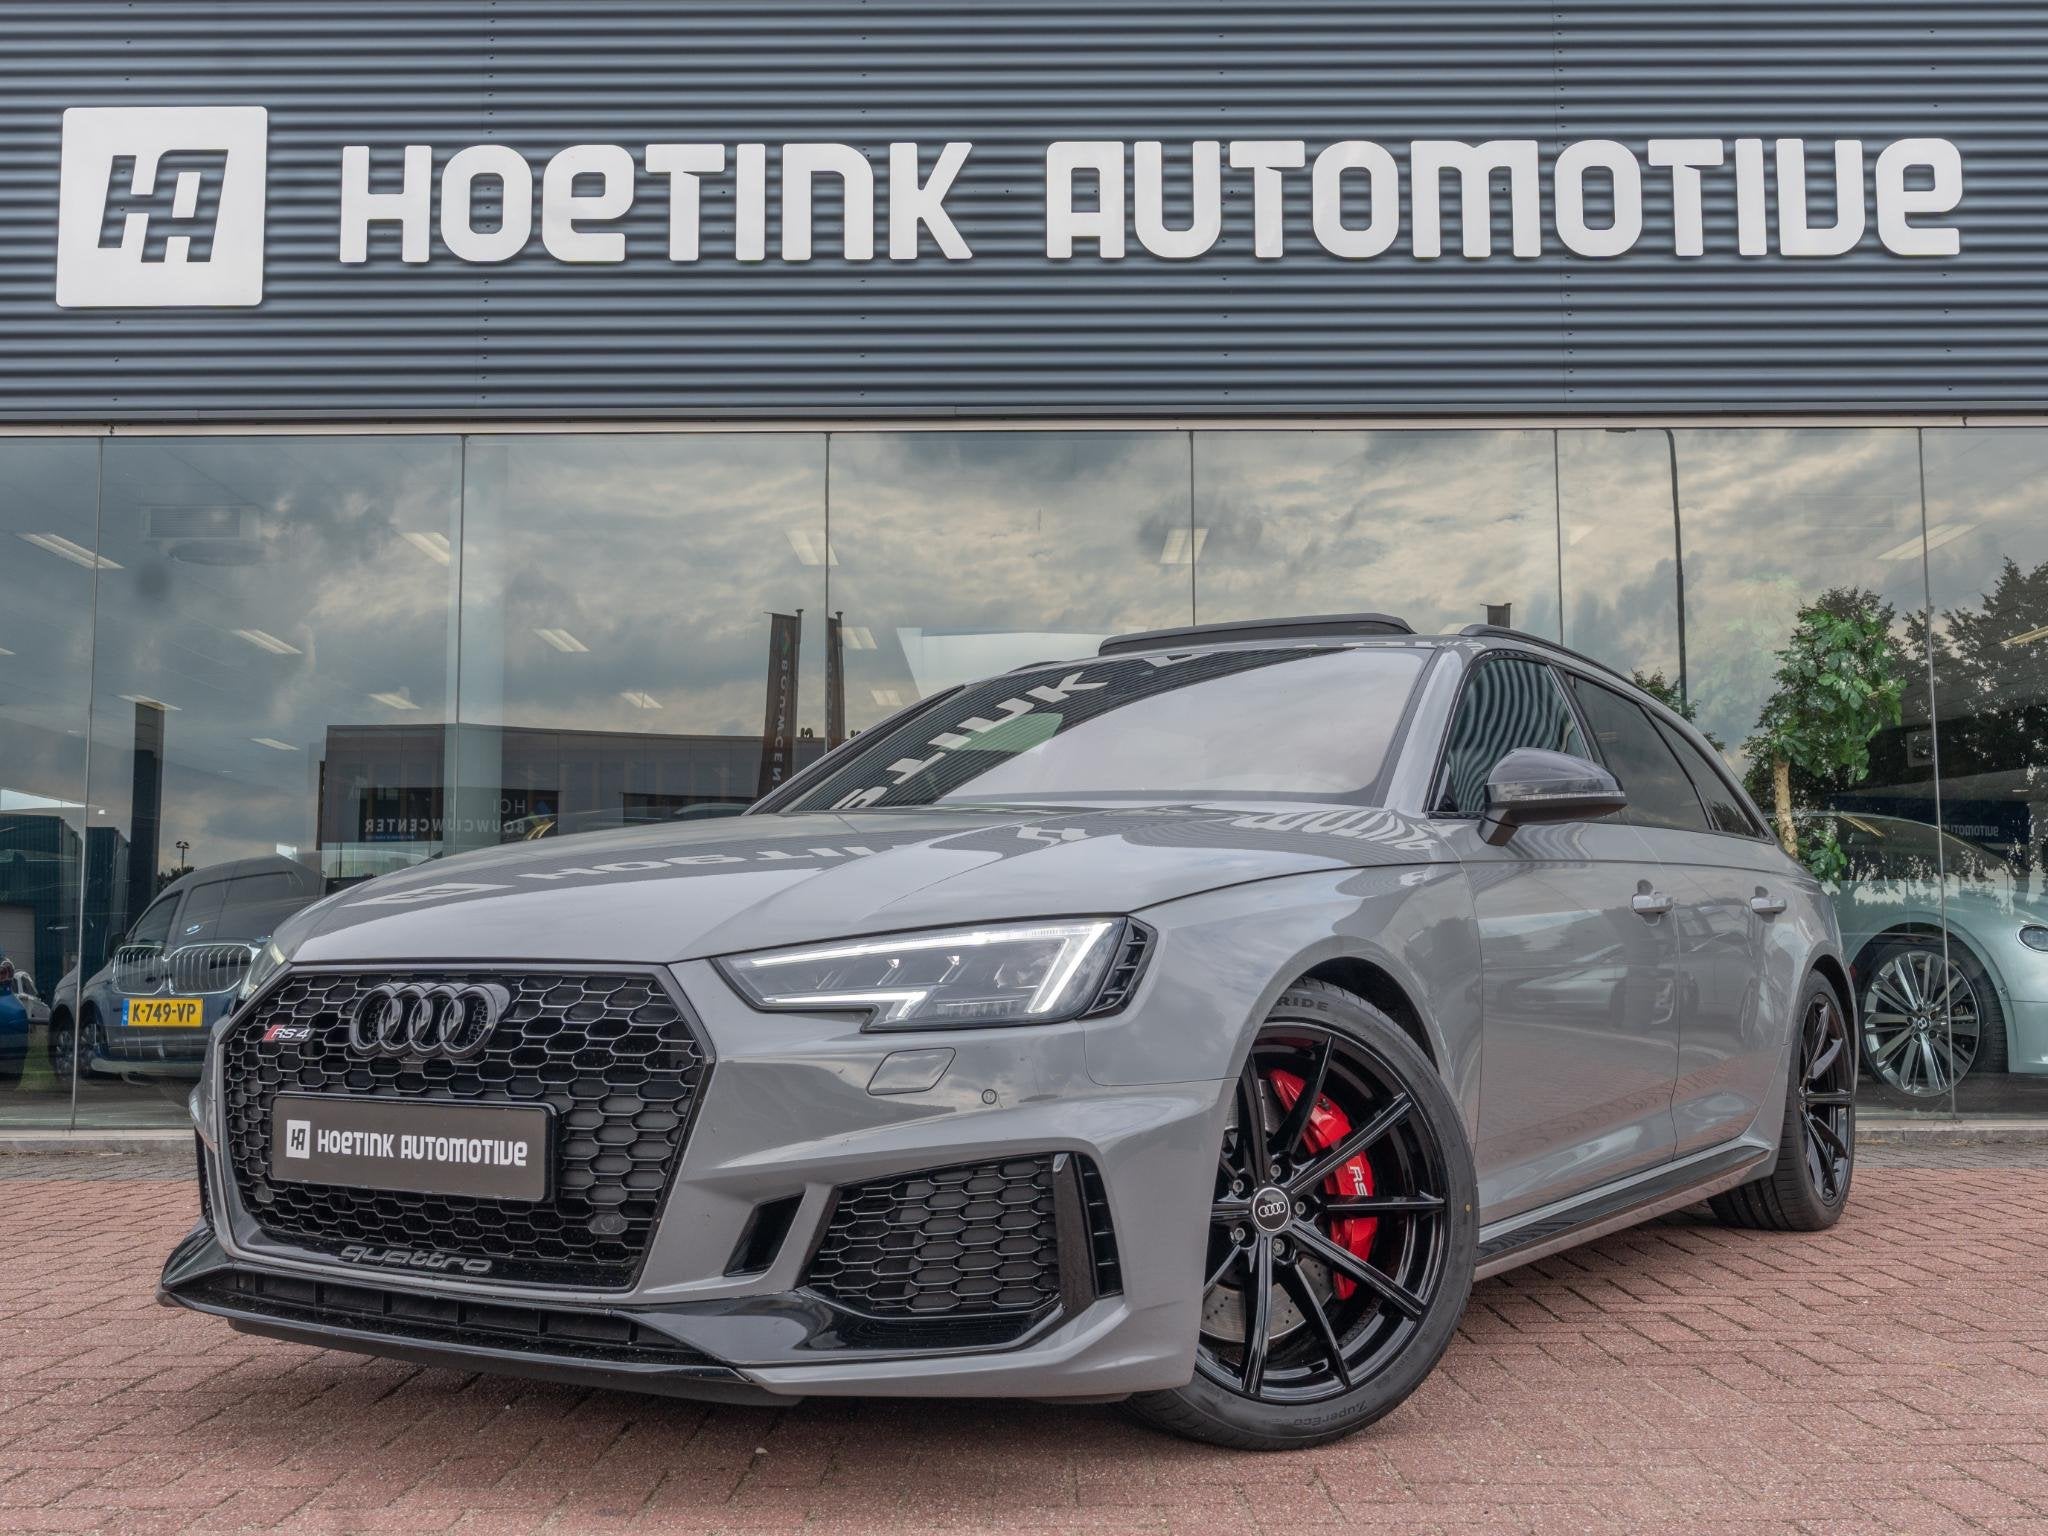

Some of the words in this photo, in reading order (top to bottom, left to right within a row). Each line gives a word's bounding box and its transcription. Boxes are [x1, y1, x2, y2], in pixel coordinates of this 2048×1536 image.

[339, 141, 974, 263] HOETINK
[1045, 137, 1963, 259] AUTOMOTIVE
[132, 1003, 197, 1023] K-749-VP
[317, 1128, 395, 1158] HOETINK
[400, 1134, 528, 1167] AUTOMOTIVE
[340, 1245, 493, 1273] quattro
